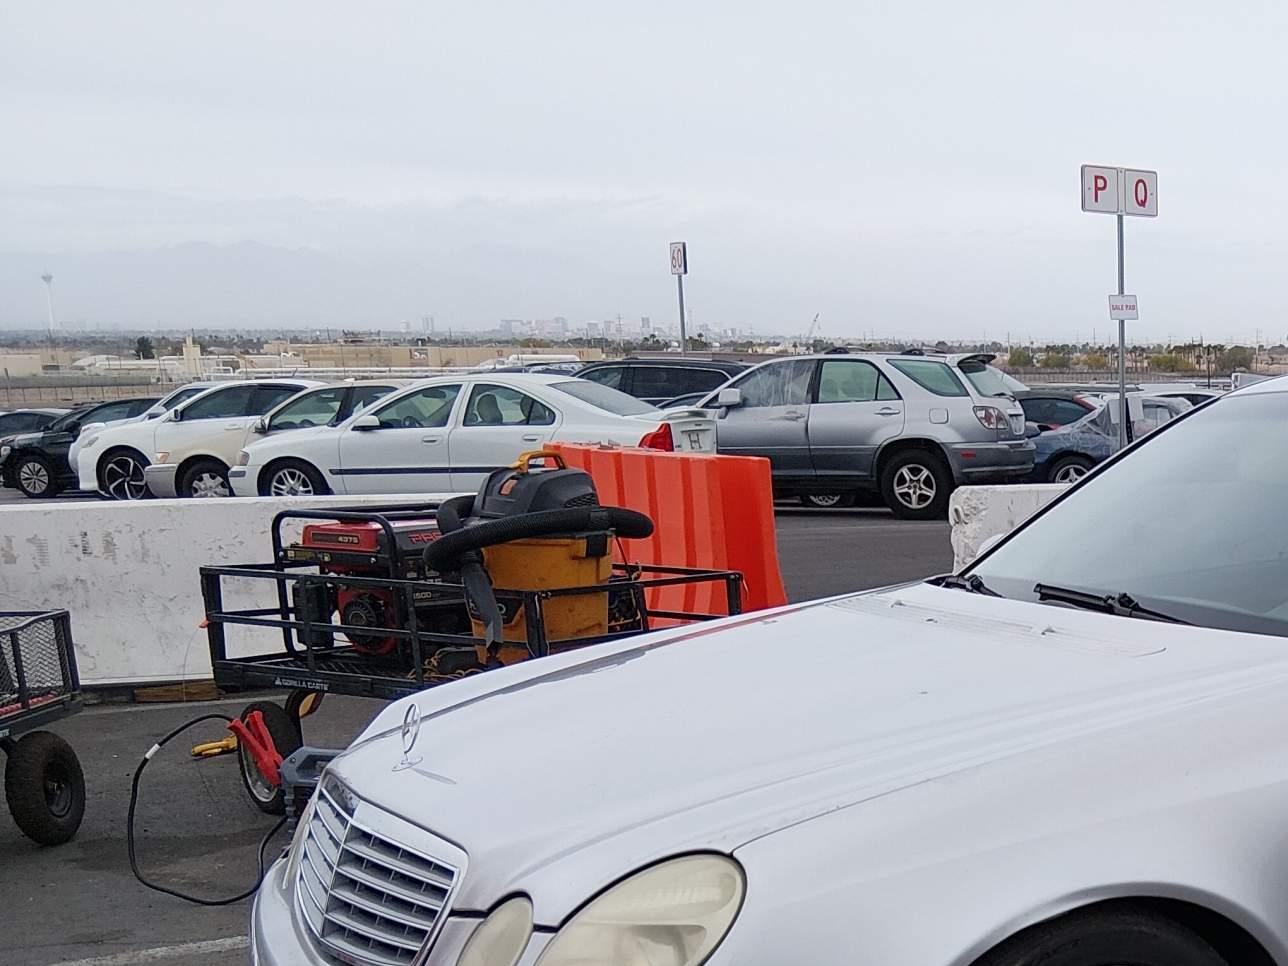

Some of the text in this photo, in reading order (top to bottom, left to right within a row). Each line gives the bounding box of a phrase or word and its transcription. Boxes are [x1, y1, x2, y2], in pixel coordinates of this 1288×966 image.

[1094, 174, 1148, 208] P Q
[671, 248, 683, 269] 60
